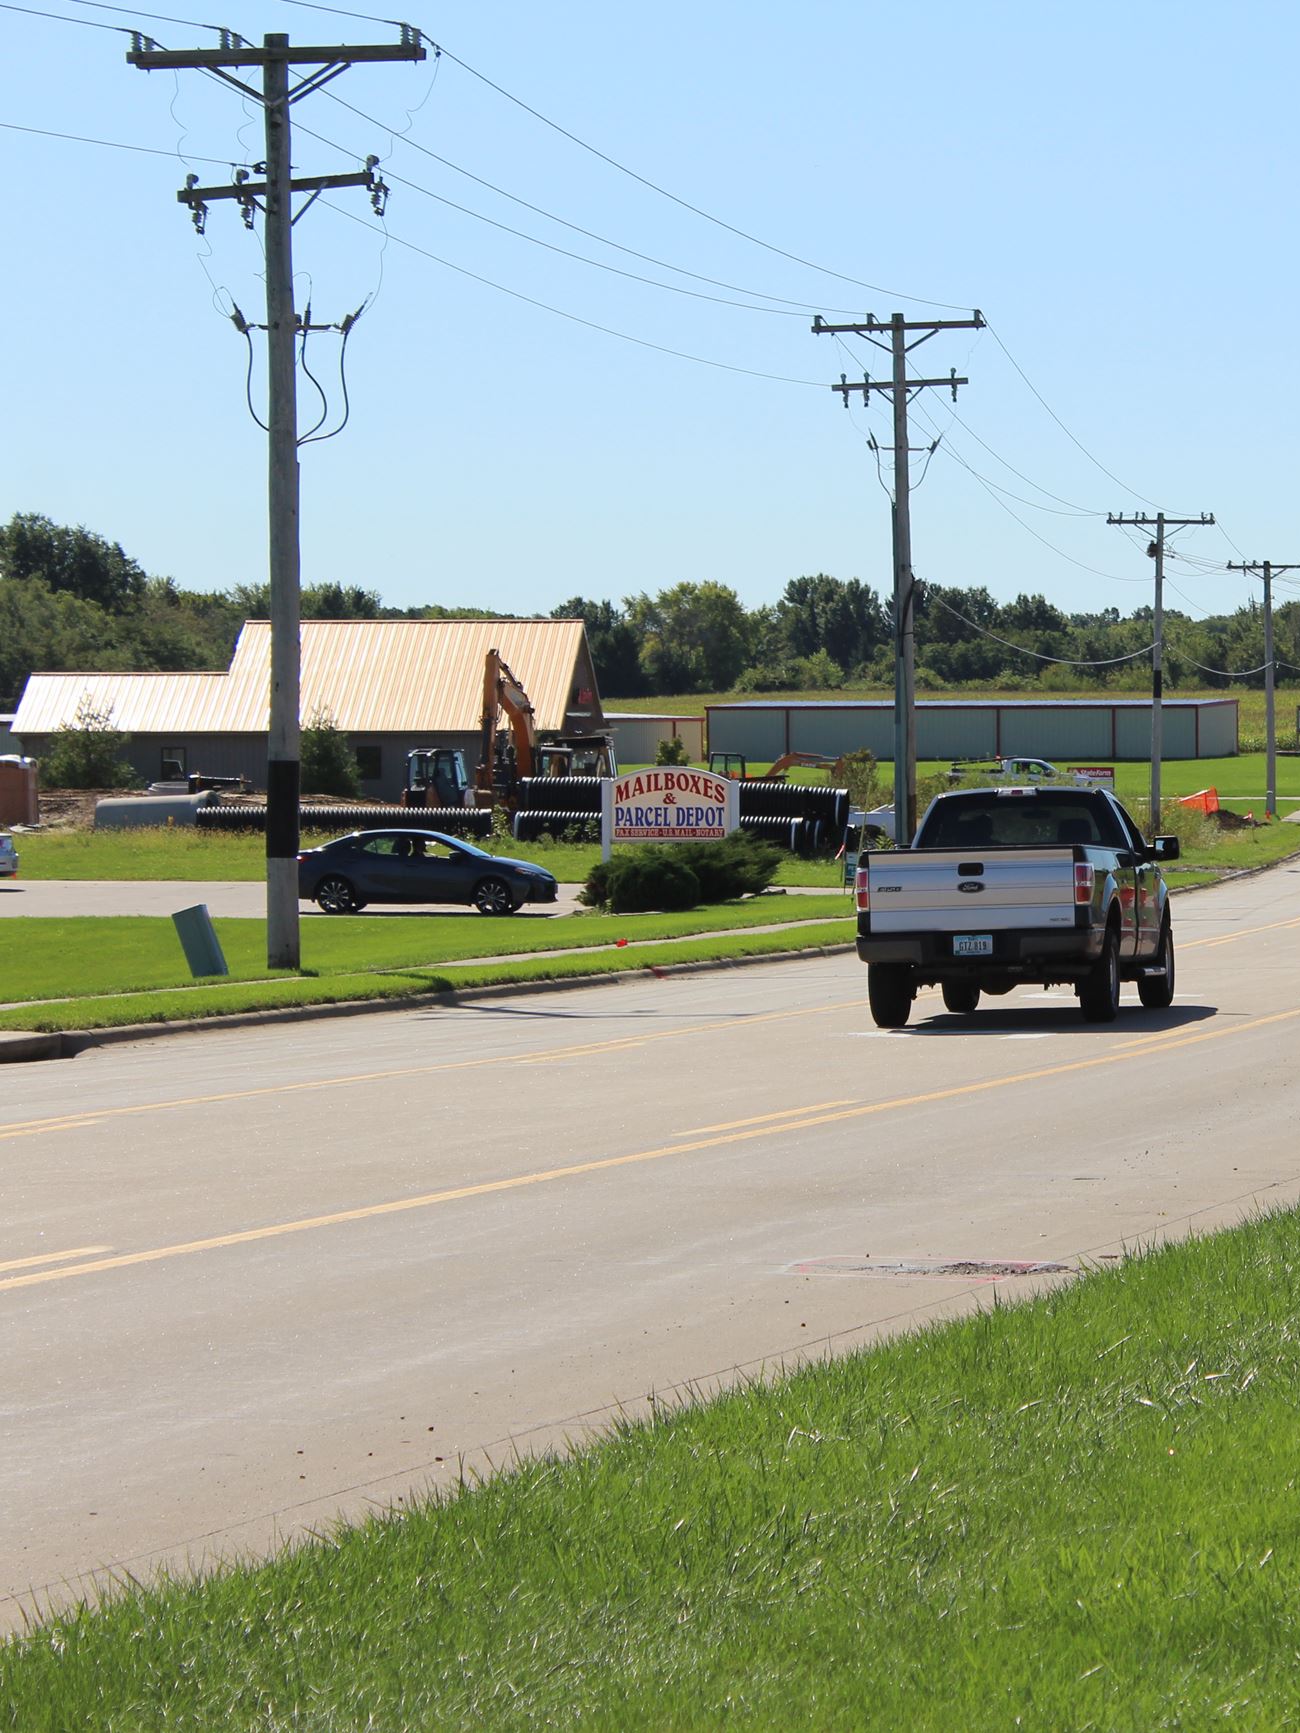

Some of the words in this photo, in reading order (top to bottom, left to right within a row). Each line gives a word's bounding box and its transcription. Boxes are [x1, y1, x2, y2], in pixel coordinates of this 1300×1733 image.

[615, 772, 725, 804] MAILBOXES
[662, 792, 677, 805] &
[615, 806, 671, 827] PARCEL
[675, 806, 725, 827] DEPOT
[615, 828, 631, 837] FAX
[631, 828, 659, 837] SERVICE
[674, 828, 693, 837] MAIL
[695, 828, 724, 837] NOTARY
